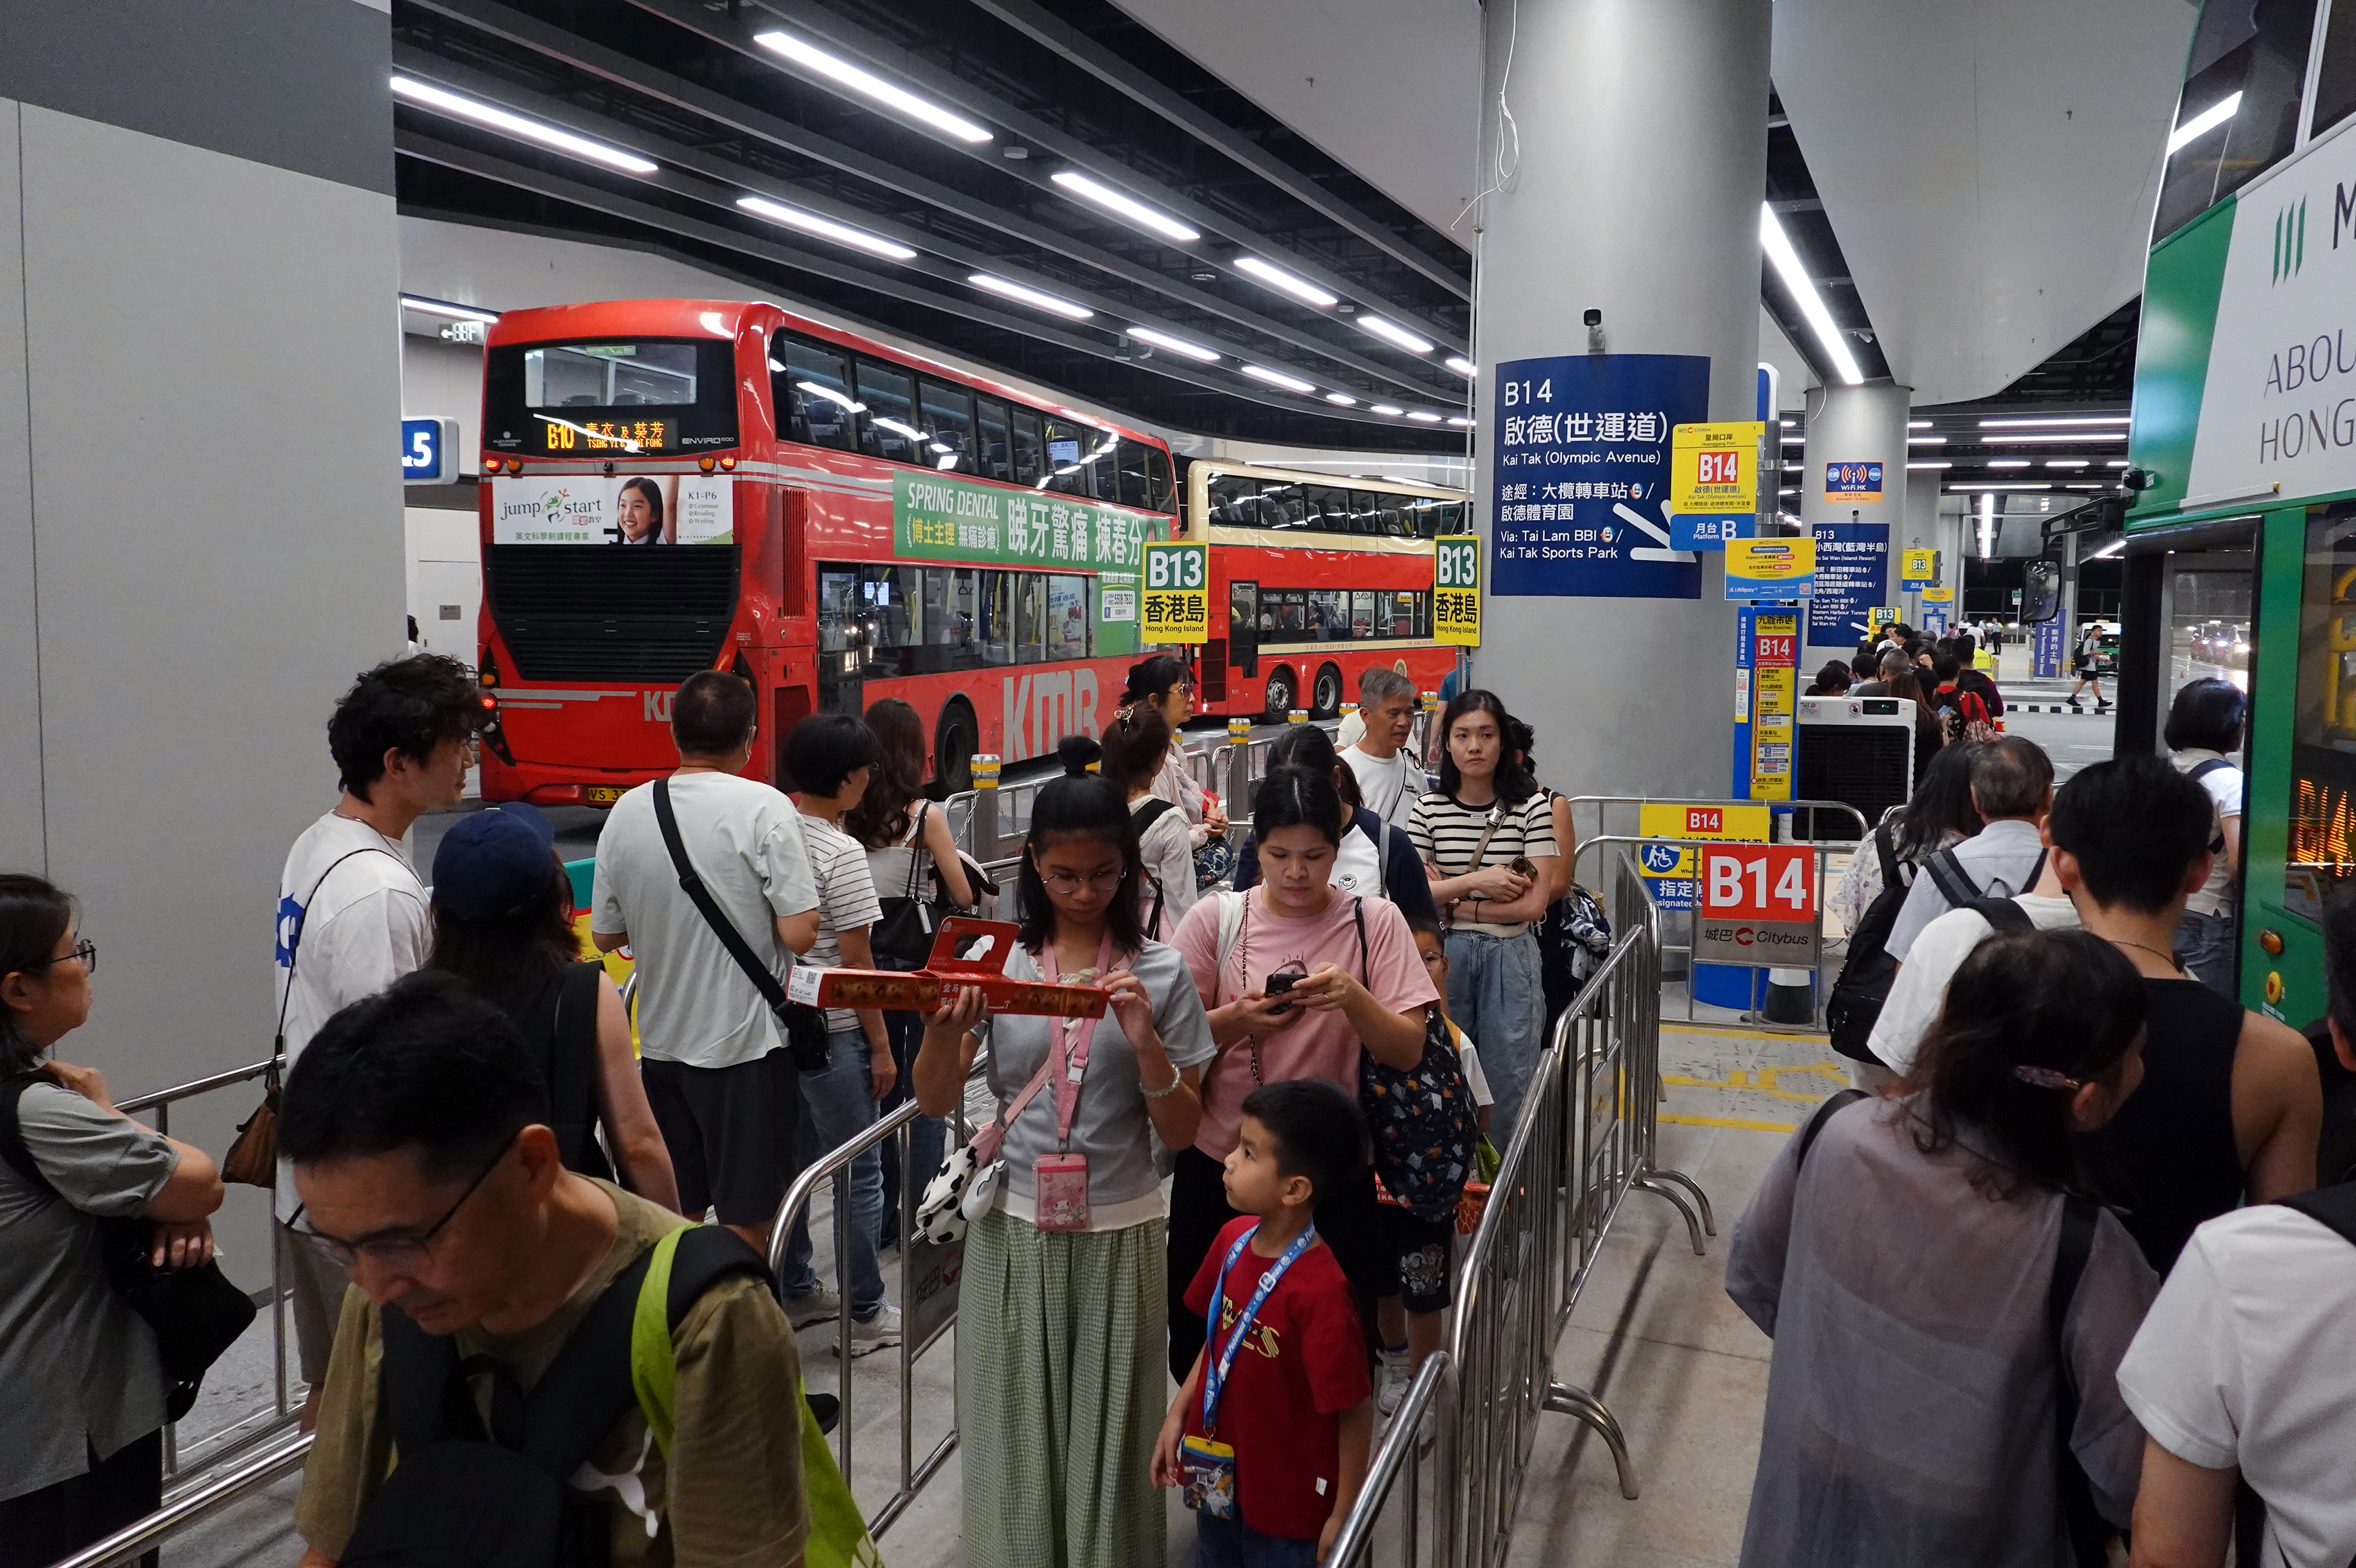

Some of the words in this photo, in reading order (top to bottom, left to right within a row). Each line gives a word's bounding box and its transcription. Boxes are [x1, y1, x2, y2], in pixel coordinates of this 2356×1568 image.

[1505, 379, 1553, 406] B14
[547, 424, 575, 449] B10
[2260, 398, 2355, 464] HONG
[587, 439, 608, 448] TSING
[610, 439, 618, 448] YI
[646, 439, 663, 448] FONG
[1503, 454, 1518, 465] Kai
[1521, 453, 1541, 465] Tak
[1545, 451, 1601, 466] (Olympic
[1606, 451, 1661, 465] Avenue)
[1699, 454, 1736, 482] B14
[501, 502, 541, 521] jump
[564, 499, 602, 514] start
[907, 482, 954, 514] SPRING
[957, 490, 999, 520] DENTAL
[912, 517, 955, 546] 博士主理
[1501, 531, 1518, 542] Via:
[1522, 530, 1539, 542] Tai
[1542, 530, 1570, 542] Lam
[1574, 530, 1597, 541] BBI
[1695, 523, 1717, 534] 月台
[1722, 520, 1737, 541] B
[1816, 530, 1835, 540] B13
[1500, 547, 1514, 559] Kai
[1518, 547, 1538, 558] Tak
[1541, 546, 1583, 560] Sports
[1587, 546, 1618, 558] Park
[1150, 550, 1202, 587] B13
[1438, 545, 1475, 585] B13
[1912, 560, 1926, 570] B13
[1144, 594, 1205, 624] 香港島
[1435, 593, 1477, 625] 香港島
[1876, 609, 1894, 619] B13
[1145, 624, 1162, 634] Hong
[1164, 624, 1180, 634] Kong
[1436, 624, 1447, 633] Hong
[1449, 625, 1460, 634] Kong
[1462, 626, 1477, 634] Island
[1760, 639, 1790, 656] B14
[1002, 667, 1100, 765] KMB
[590, 789, 605, 800] VS
[1690, 813, 1719, 829] B14
[1709, 855, 1806, 909] B14
[1705, 929, 1733, 942] 城巴
[1756, 931, 1809, 945] Citybus
